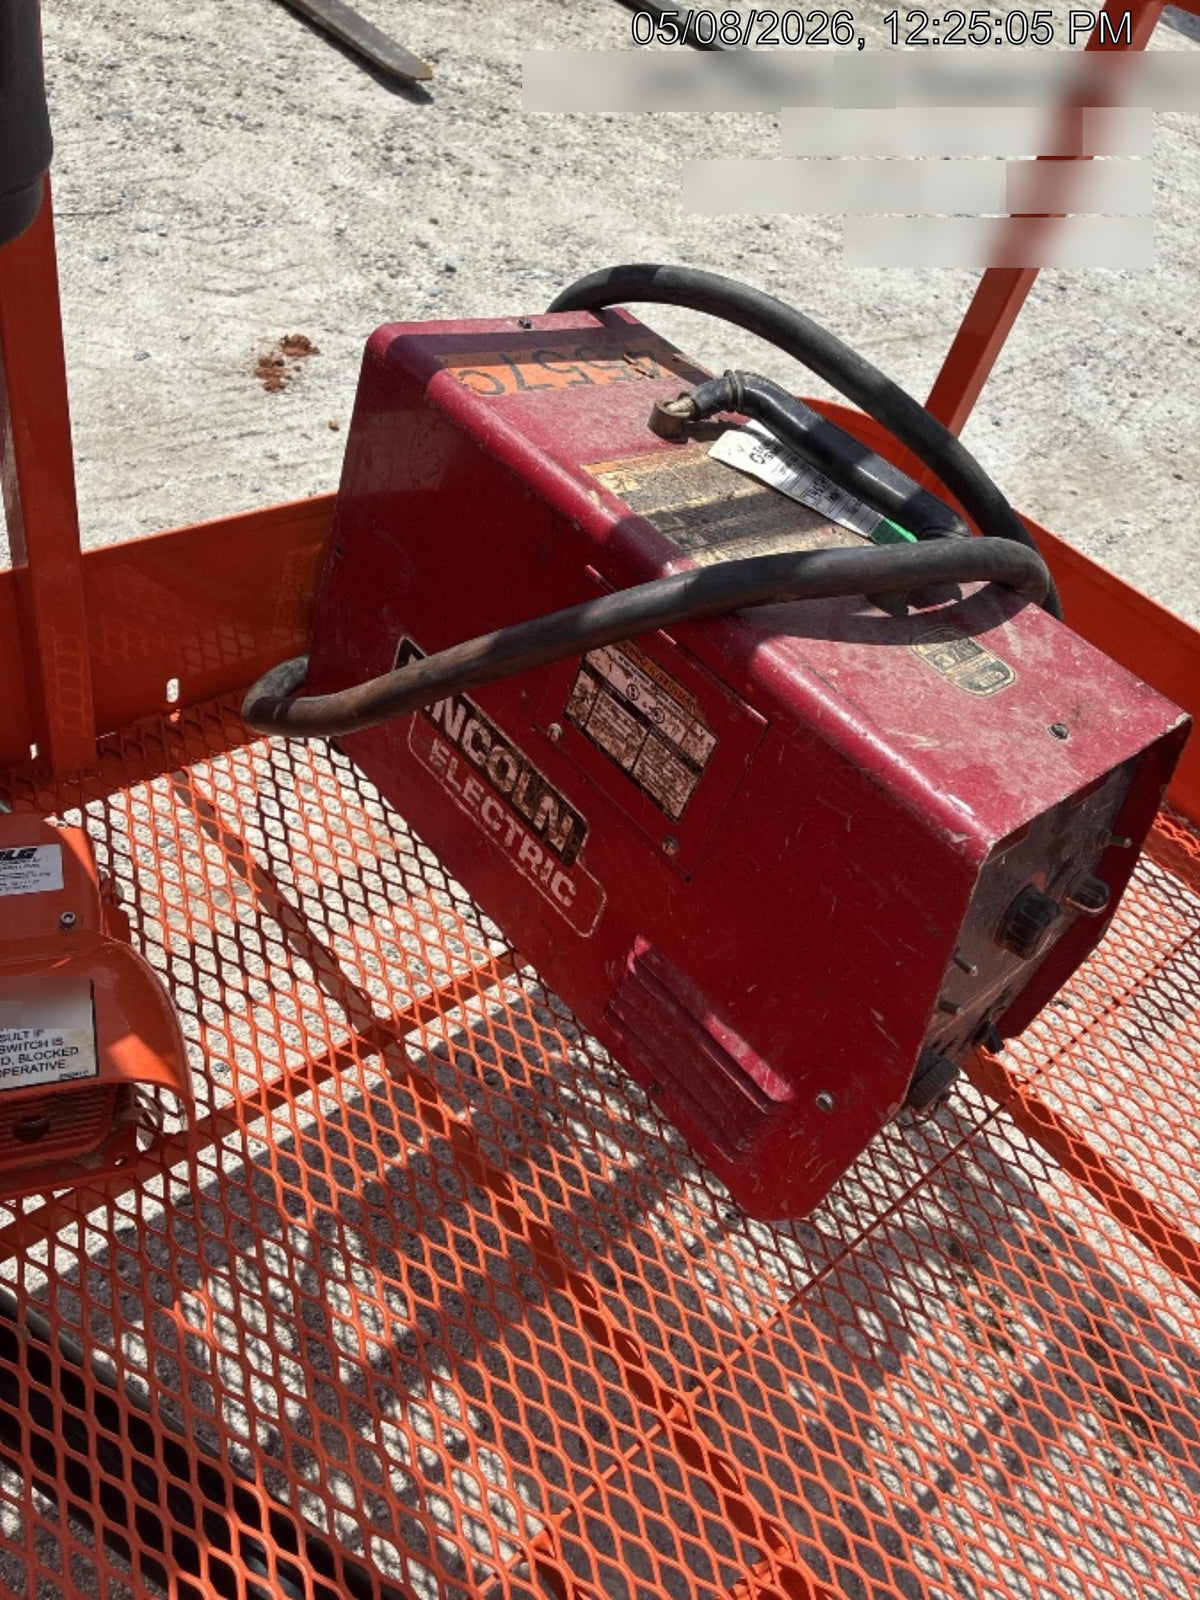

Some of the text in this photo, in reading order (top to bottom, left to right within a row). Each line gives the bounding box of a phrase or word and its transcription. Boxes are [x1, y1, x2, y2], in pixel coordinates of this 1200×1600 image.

[429, 737, 577, 907] ELECTRIC
[0, 1036, 64, 1055] SWITCH IS
[18, 1046, 79, 1063] BLOCKED
